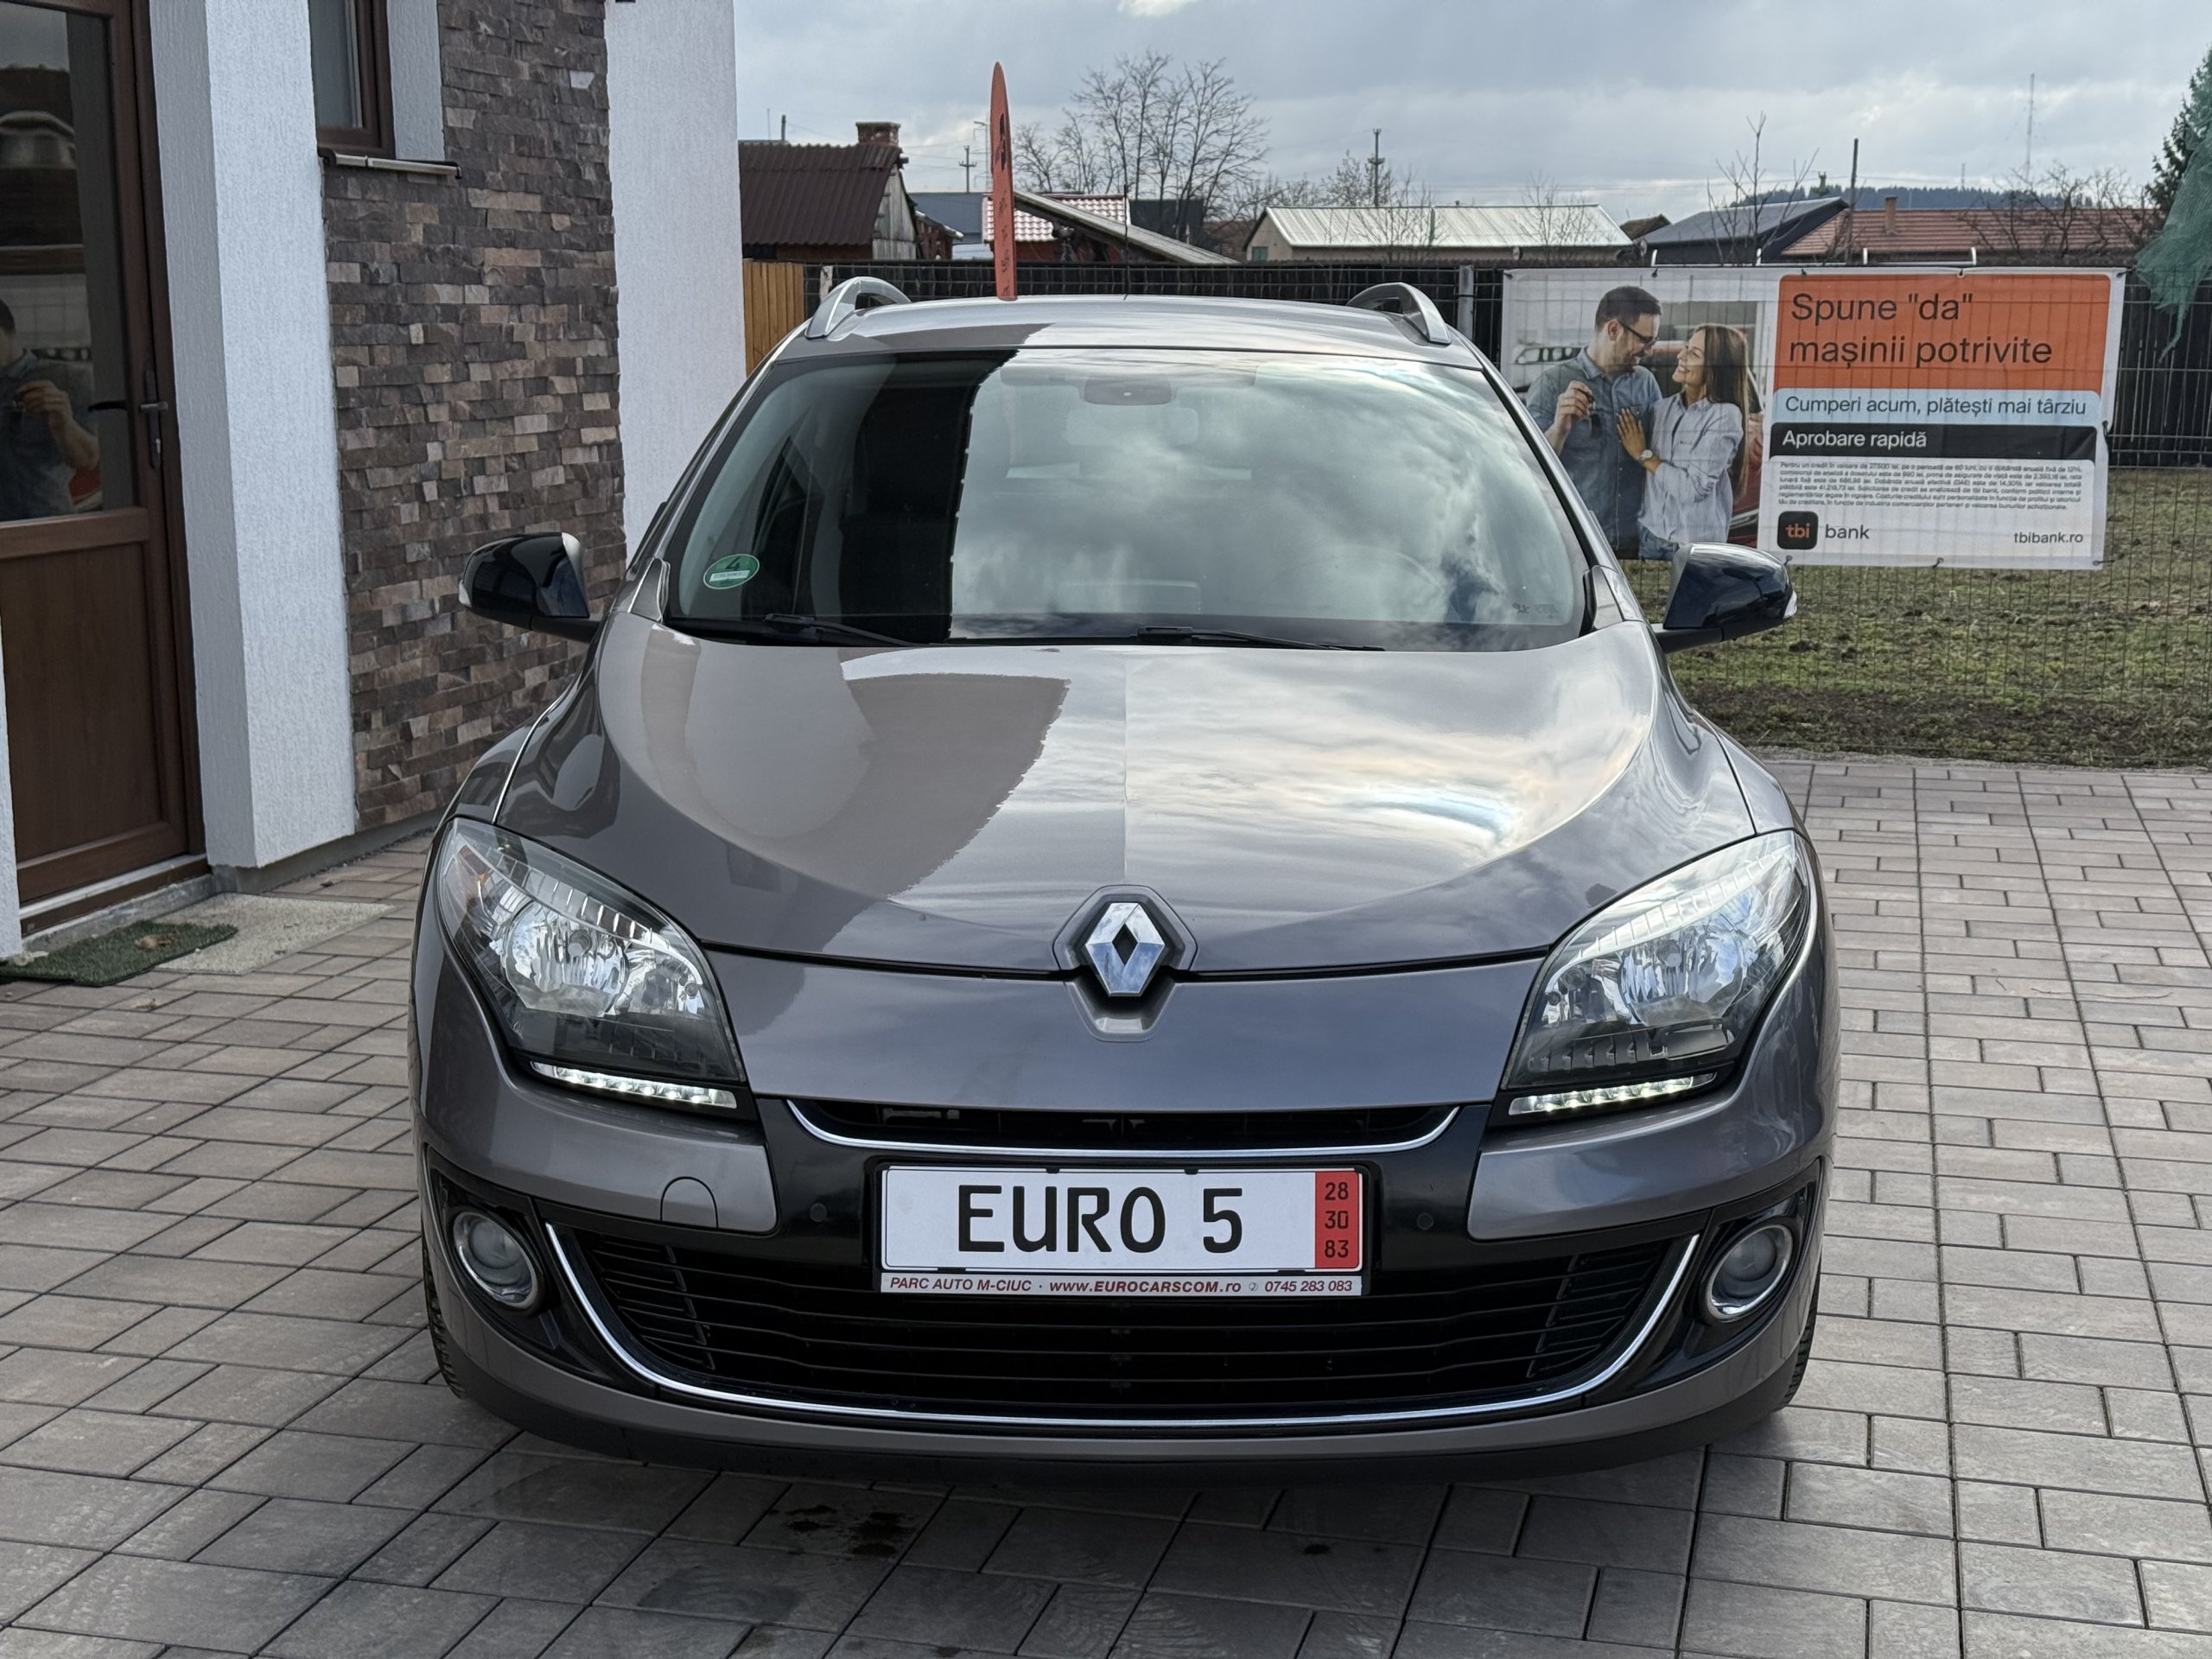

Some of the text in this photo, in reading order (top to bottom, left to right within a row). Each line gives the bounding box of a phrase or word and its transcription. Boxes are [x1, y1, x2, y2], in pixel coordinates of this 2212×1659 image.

[1791, 292, 1974, 326] Spune "da"
[1789, 335, 2053, 369] mașinii potrivite
[1785, 396, 2087, 416] Cumperi acum, plătești mai târziu
[1782, 429, 1927, 450] Aprobare rapidă
[1785, 522, 1871, 539] tbi bank
[2013, 531, 2084, 543] tbibank.ro
[725, 556, 741, 571] 4
[1325, 1182, 1350, 1201] 28
[957, 1185, 1243, 1253] EURO 5
[1324, 1211, 1349, 1229] 30
[1324, 1240, 1349, 1259] 83
[890, 1277, 1353, 1293] PARC AUTO M-CIUC www.EUROCARSCOM.ro 0745 283 083
